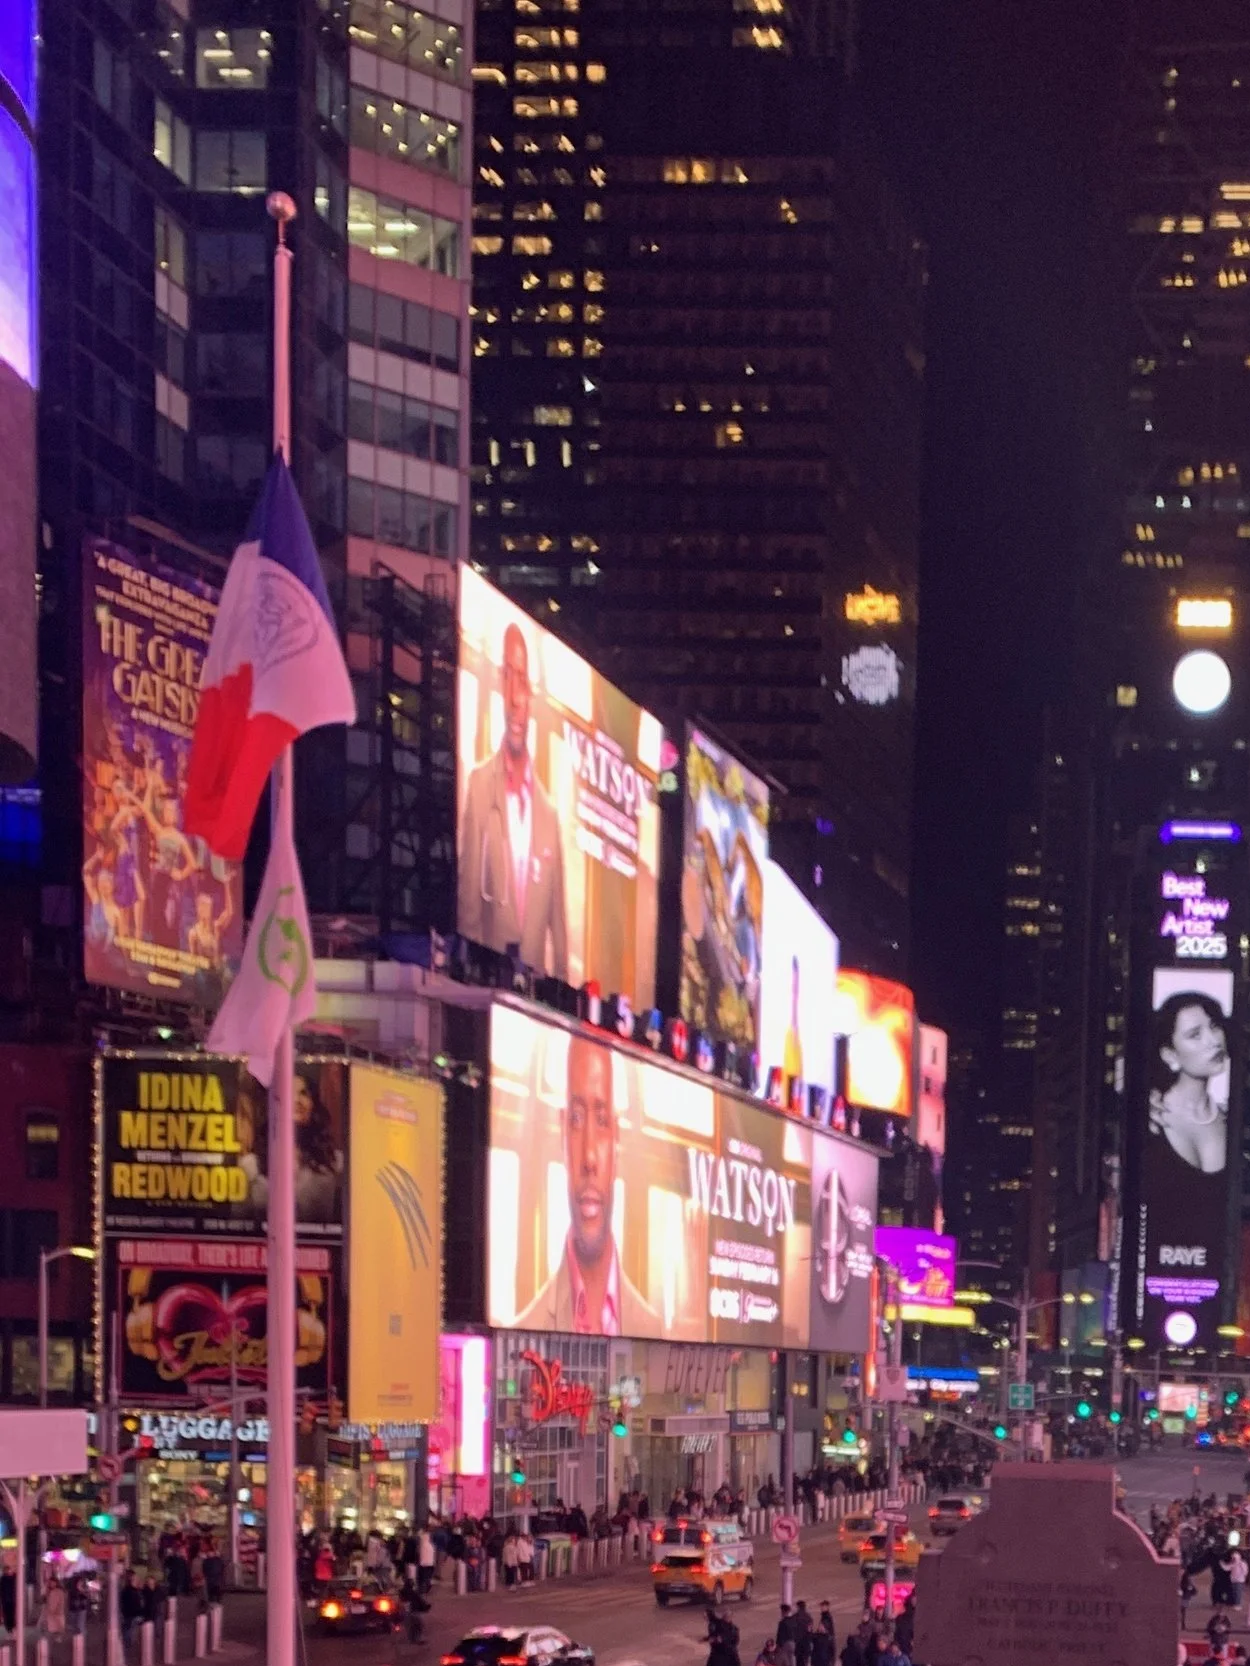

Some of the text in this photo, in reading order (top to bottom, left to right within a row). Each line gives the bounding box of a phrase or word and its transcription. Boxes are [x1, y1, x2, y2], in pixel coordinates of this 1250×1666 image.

[96, 607, 145, 666] THE
[148, 635, 202, 690] GRE
[113, 660, 200, 726] GATSB
[1162, 873, 1206, 898] Best
[1161, 912, 1215, 936] Artist
[1183, 898, 1229, 919] New
[1176, 933, 1228, 959] 2025
[138, 1072, 225, 1112] IDINA
[118, 1111, 241, 1152] MENZEL
[112, 1161, 248, 1203] REDWOOD
[687, 1147, 796, 1238] WATSON
[1159, 1244, 1207, 1266] RAYE
